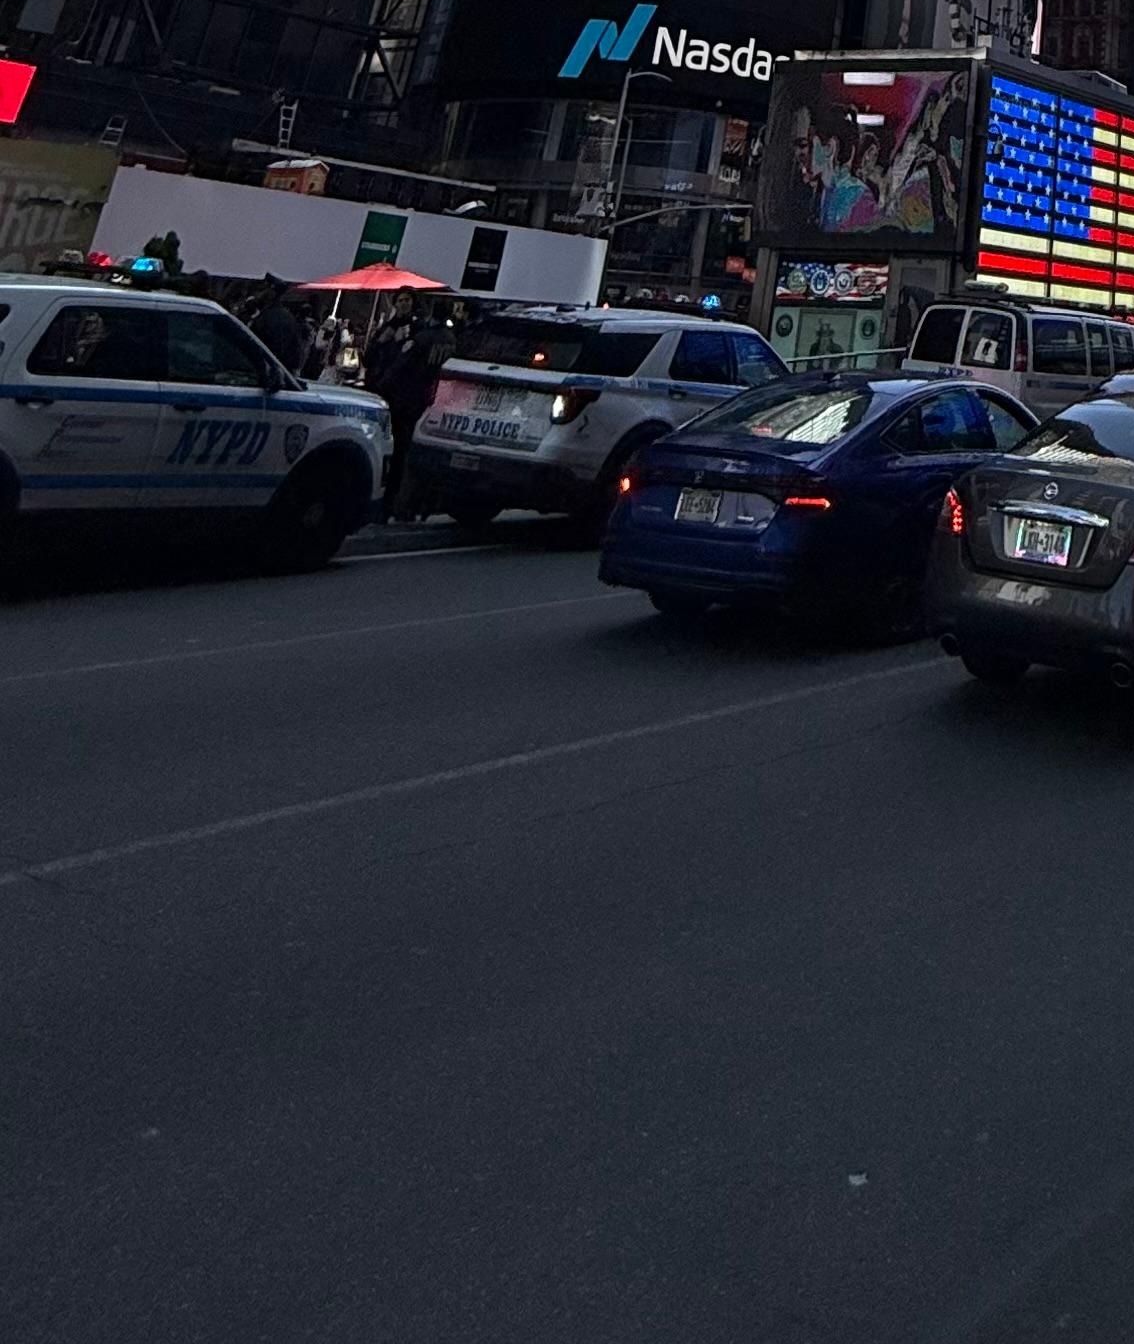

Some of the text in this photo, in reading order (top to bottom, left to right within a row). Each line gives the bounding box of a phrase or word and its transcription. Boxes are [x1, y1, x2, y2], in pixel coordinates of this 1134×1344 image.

[651, 26, 790, 82] Nasda
[165, 419, 273, 465] NYPD
[440, 413, 520, 439] NYPD POLICE
